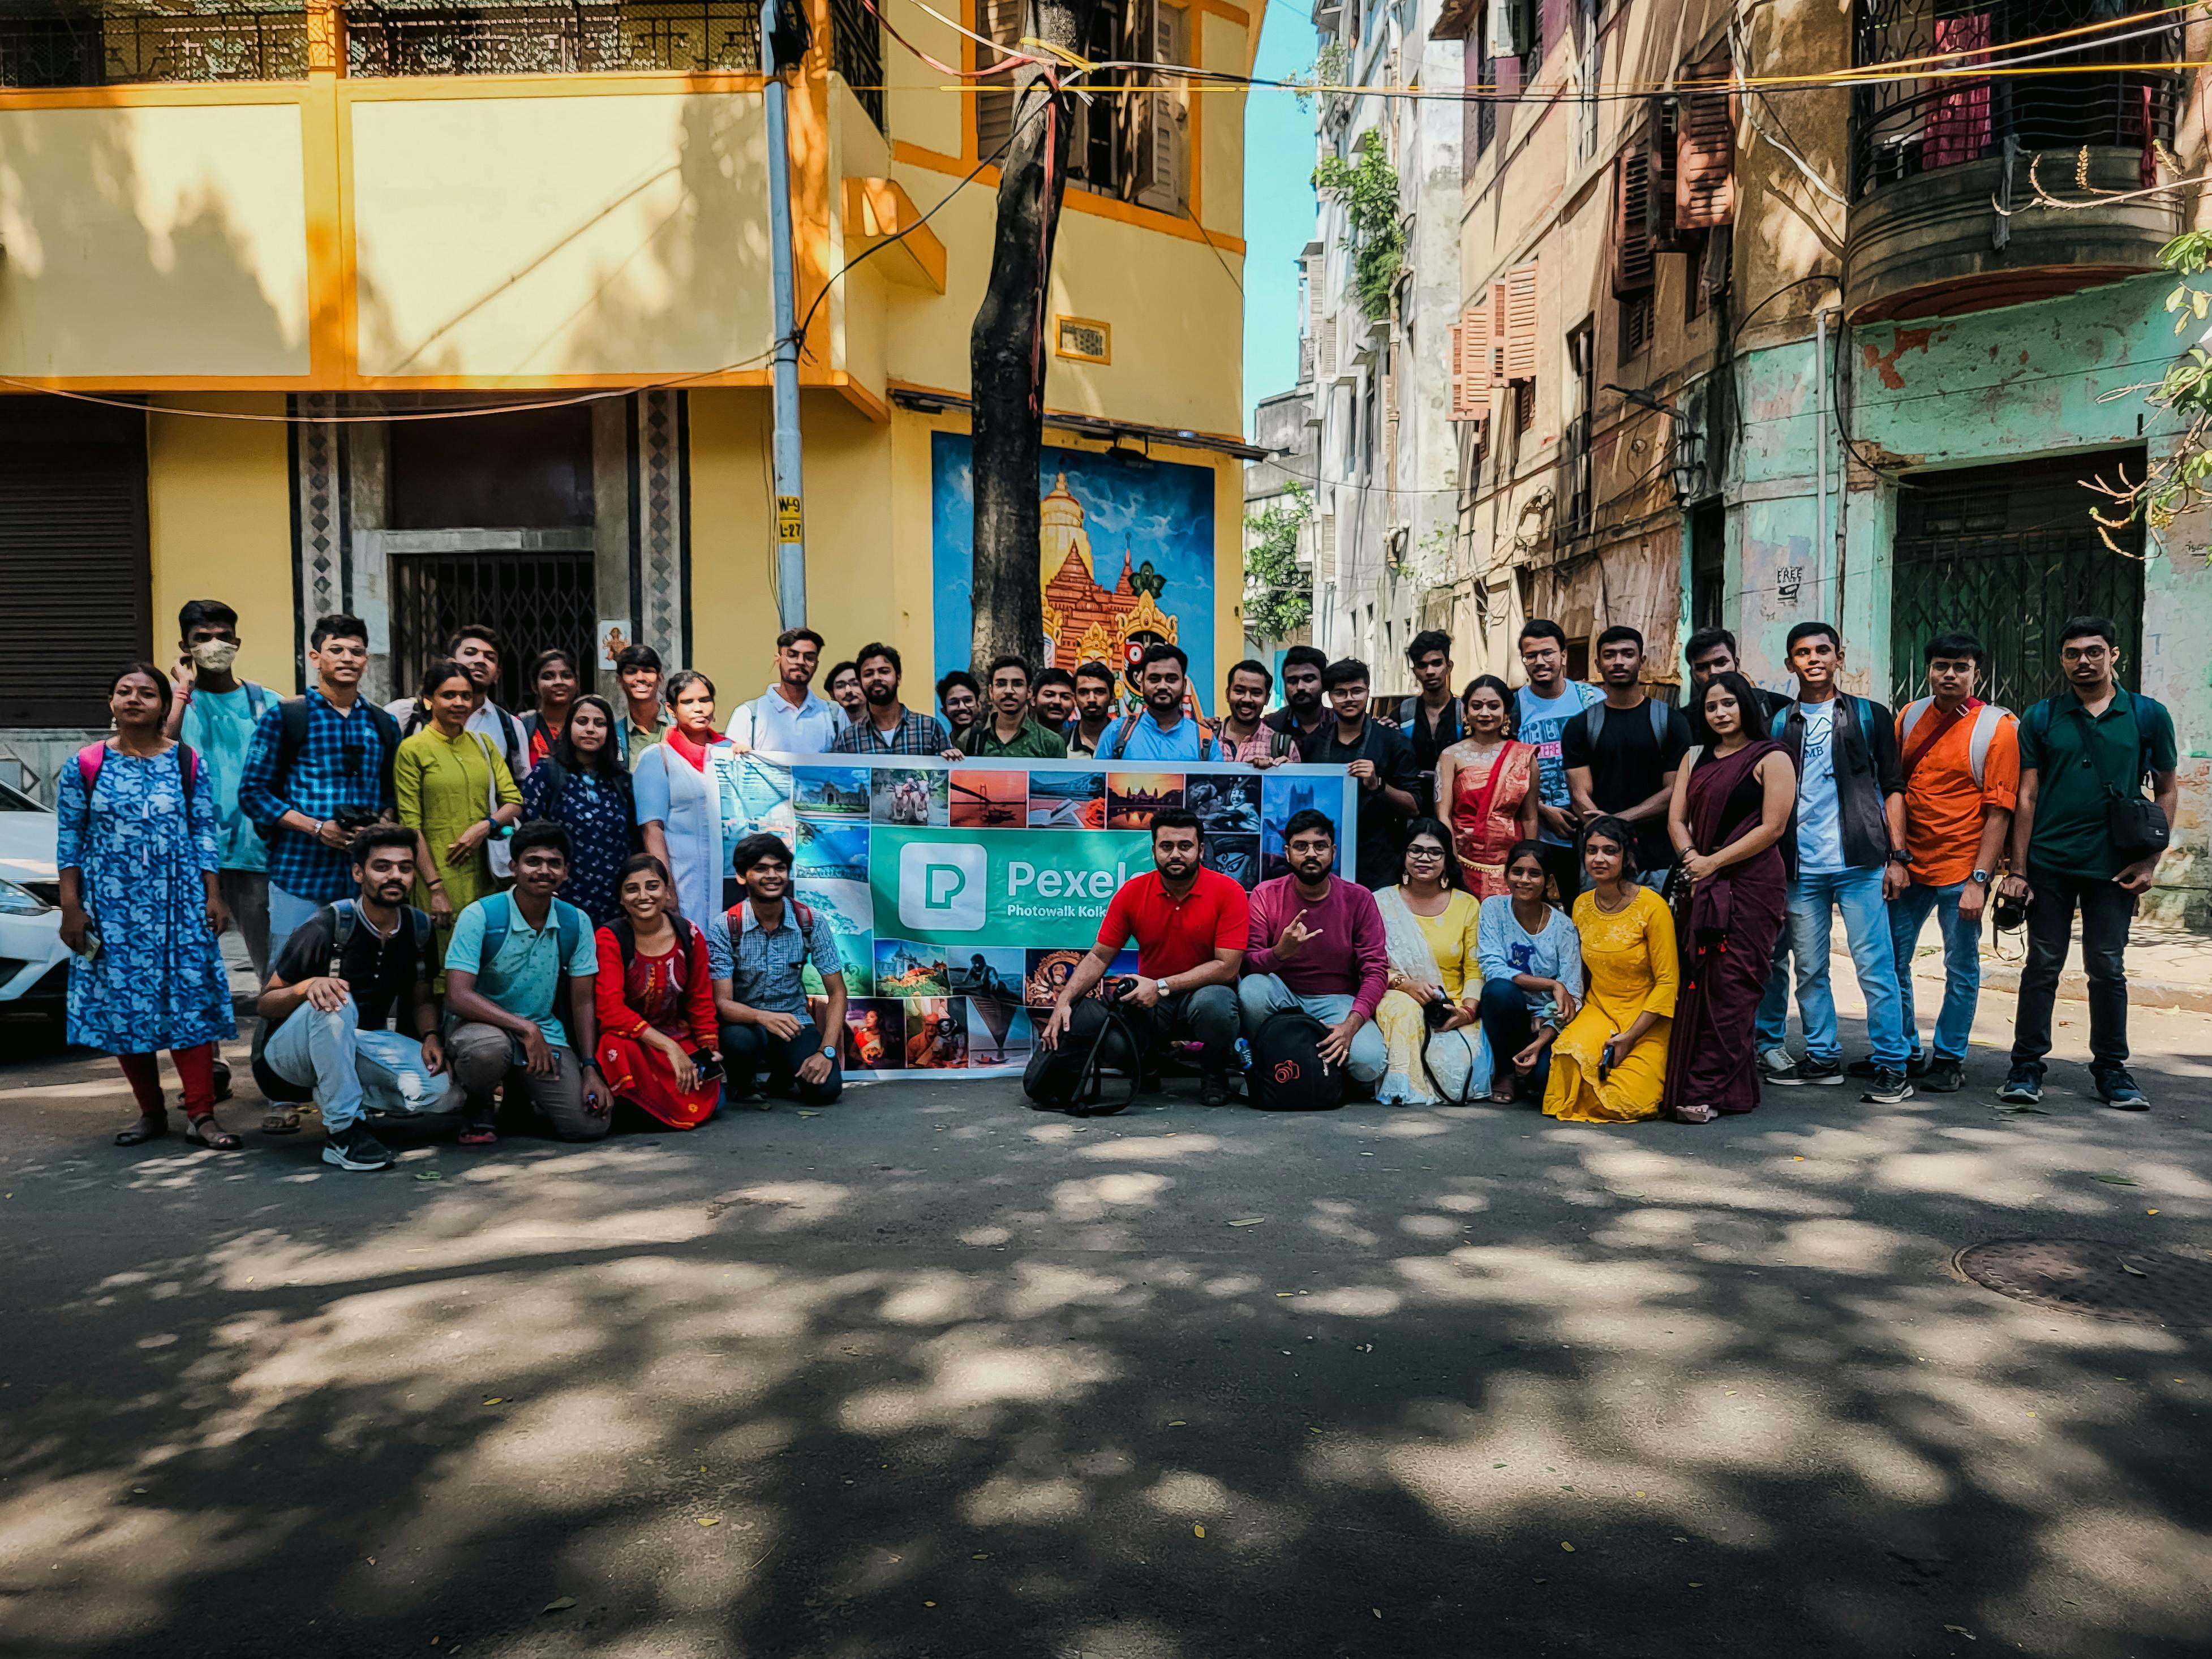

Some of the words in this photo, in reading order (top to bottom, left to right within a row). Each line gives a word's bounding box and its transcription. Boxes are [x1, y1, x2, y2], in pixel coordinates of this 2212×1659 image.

[780, 523, 801, 537] L-27
[1777, 568, 1802, 583] FREE
[1008, 861, 1146, 898] Pexel
[1007, 904, 1075, 917] Photowalk
